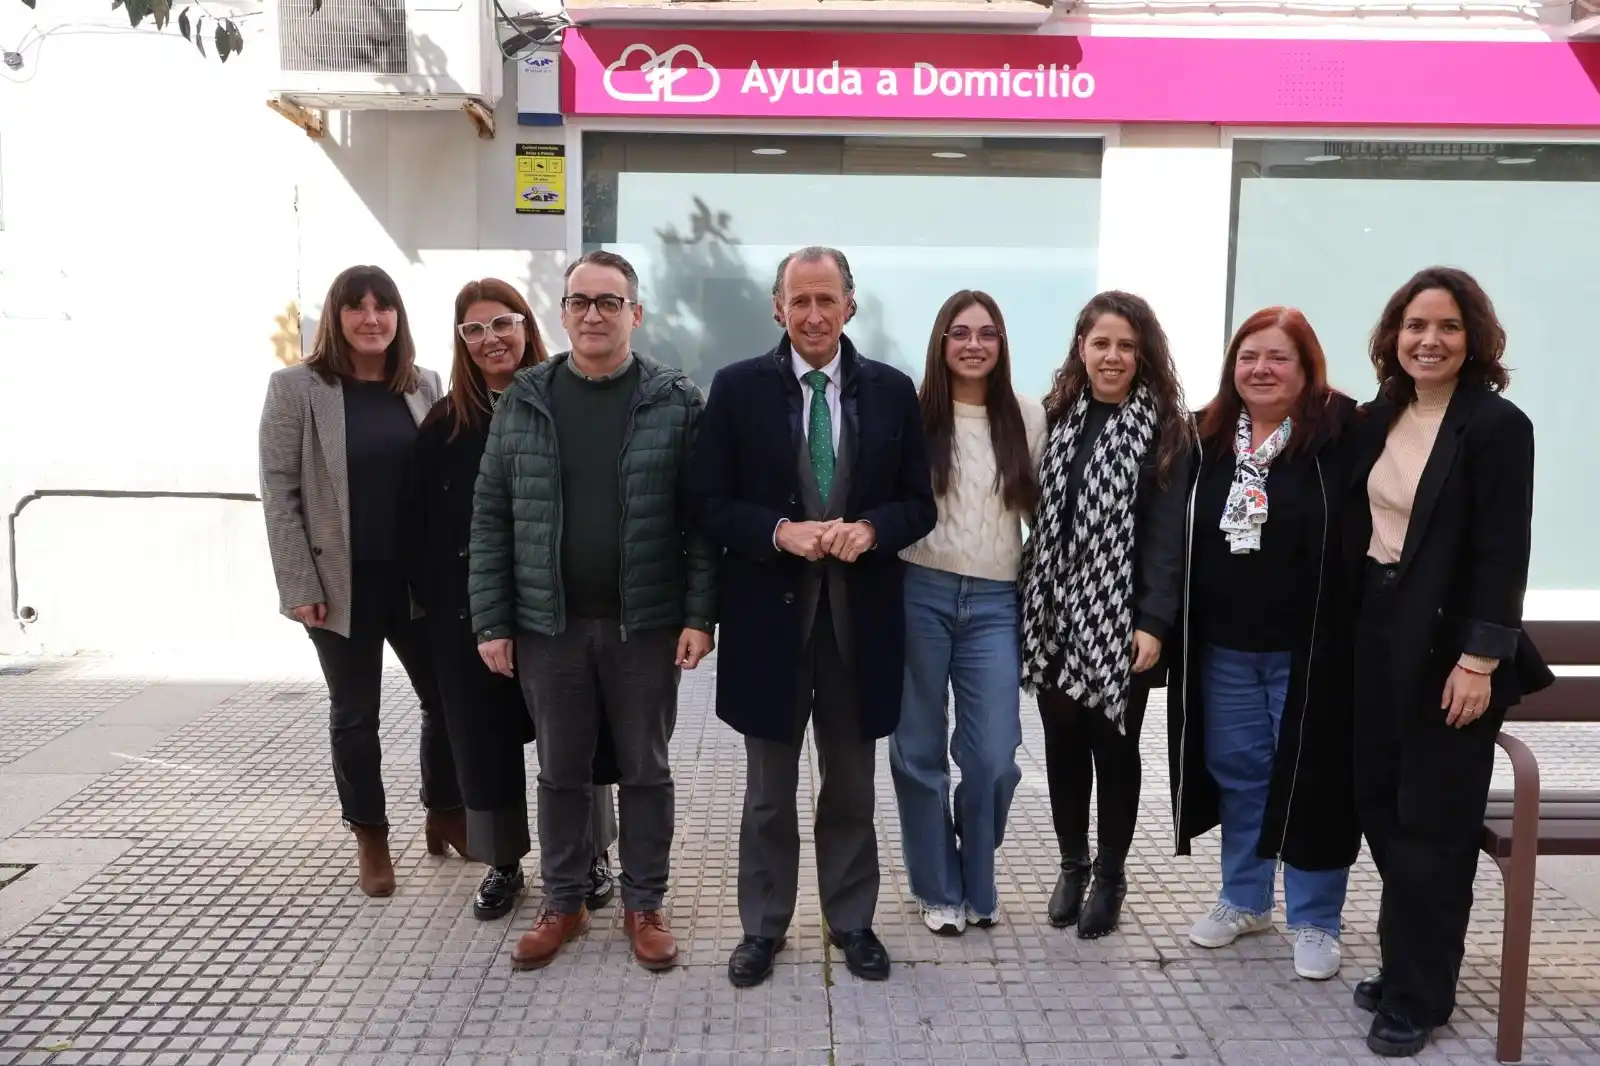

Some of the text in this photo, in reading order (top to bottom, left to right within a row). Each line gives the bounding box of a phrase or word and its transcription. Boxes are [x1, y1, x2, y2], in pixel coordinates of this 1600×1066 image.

[740, 60, 1096, 103] Ayuda a Domicilio
